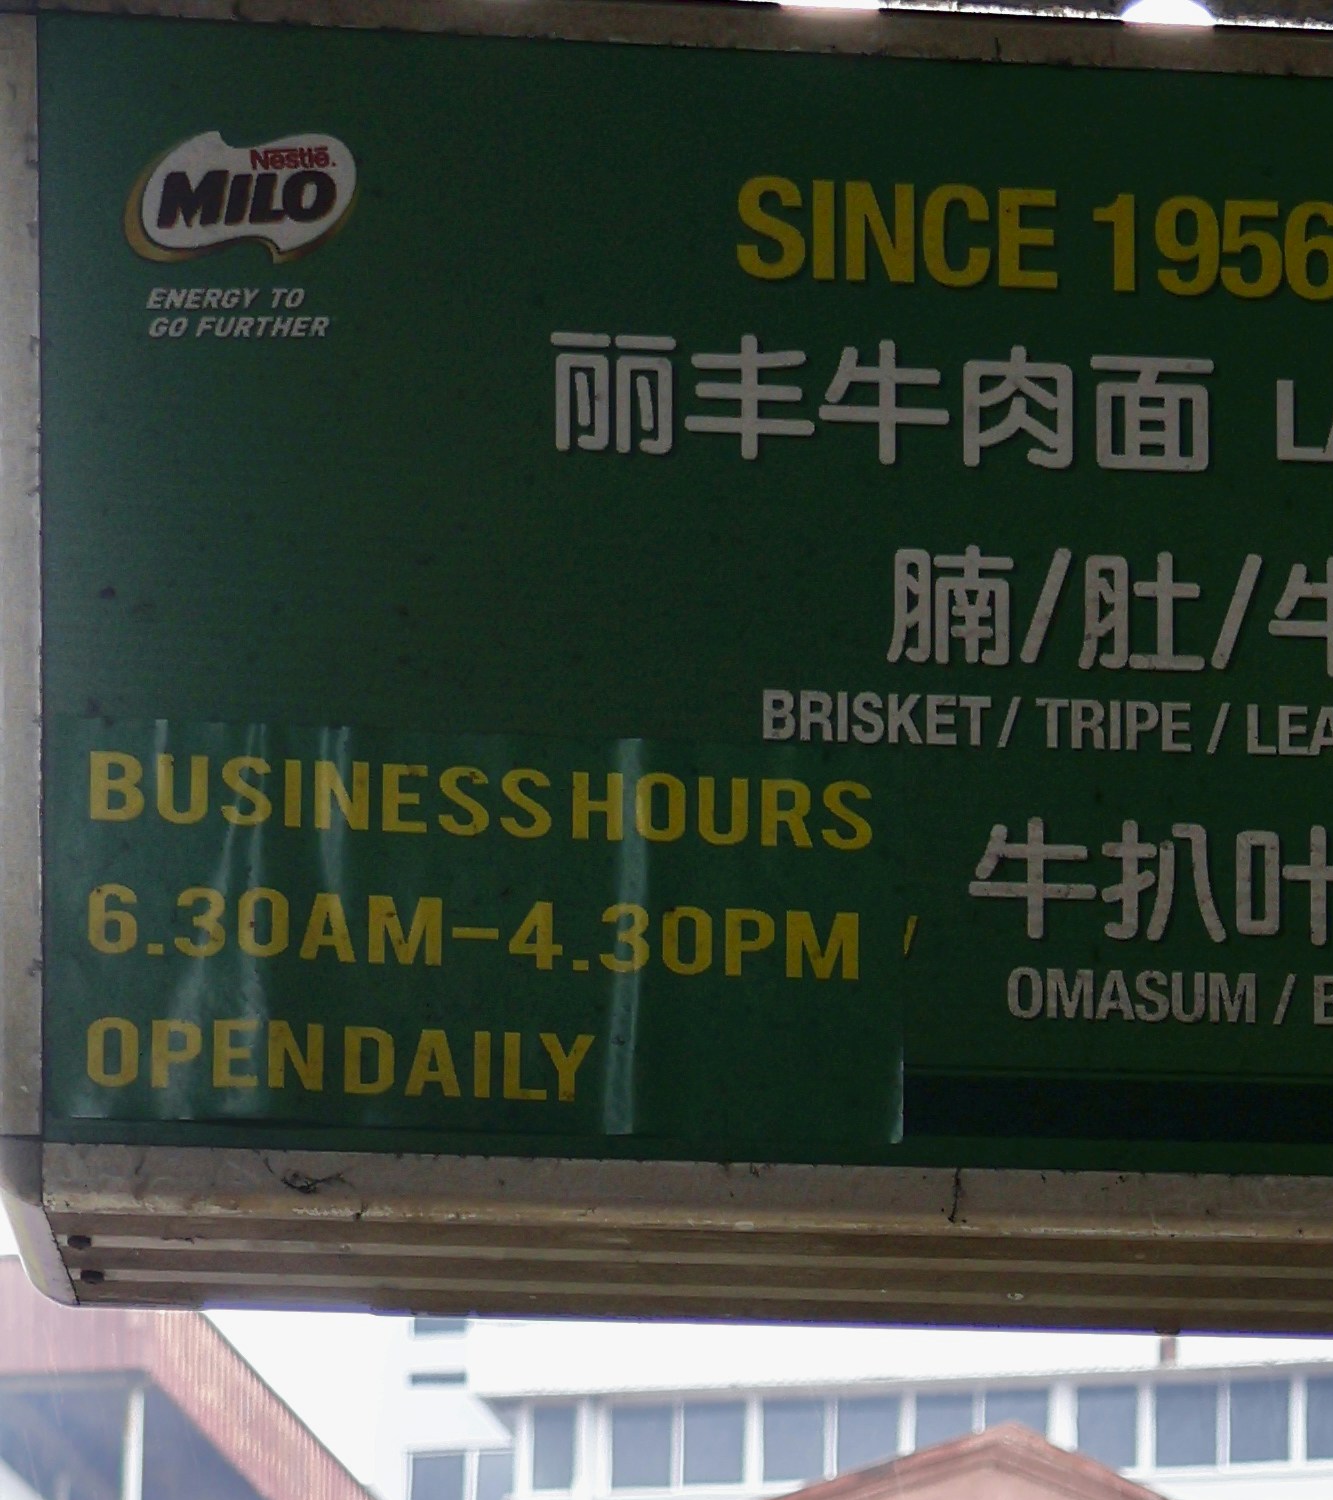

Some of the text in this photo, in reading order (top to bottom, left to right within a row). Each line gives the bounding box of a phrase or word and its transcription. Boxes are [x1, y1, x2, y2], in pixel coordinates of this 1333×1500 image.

[157, 170, 337, 229] MILO
[737, 176, 1058, 289] SINCE
[146, 287, 305, 310] ENERGY TO
[148, 316, 331, 338] GO FURTHER
[550, 331, 1215, 472] 丽丰牛肉面
[1036, 697, 1192, 752] TRIPE
[1007, 966, 1256, 1023] OMASUM
